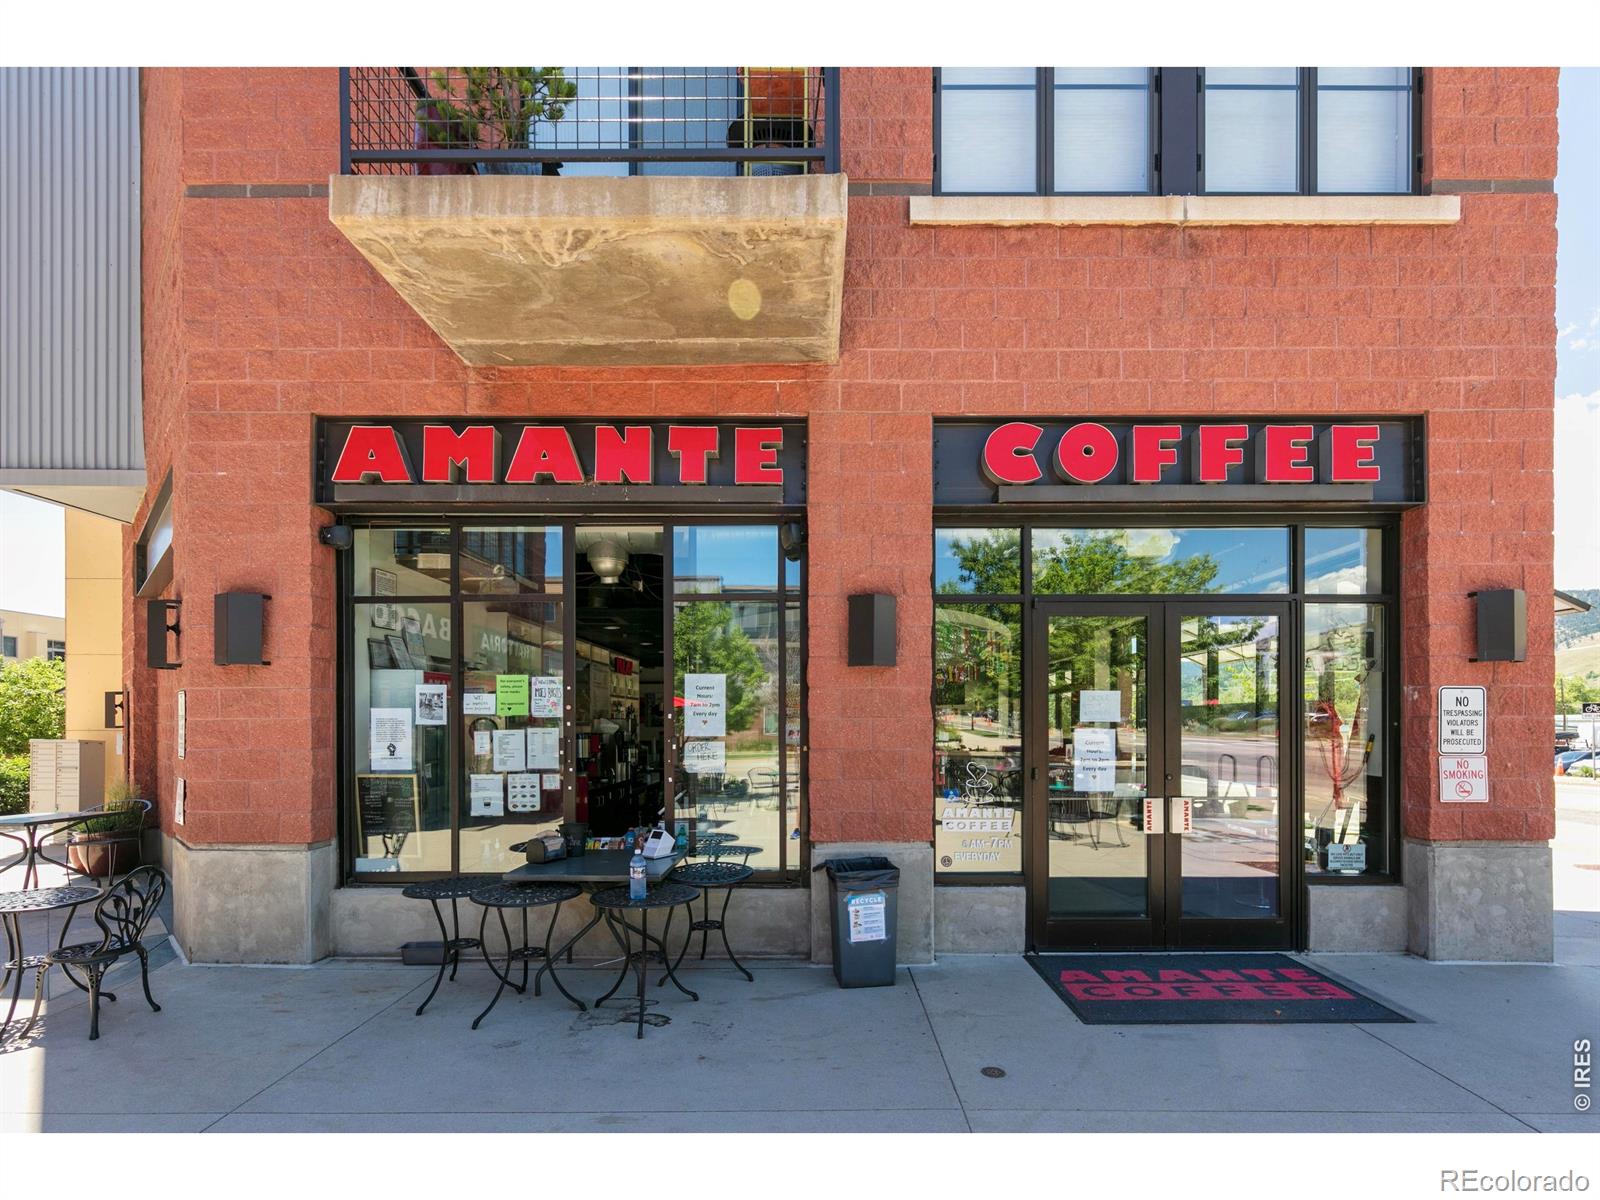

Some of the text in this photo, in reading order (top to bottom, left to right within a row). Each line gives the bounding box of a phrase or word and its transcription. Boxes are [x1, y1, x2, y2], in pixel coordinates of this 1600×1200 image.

[331, 425, 784, 484] AMANTE
[982, 422, 1381, 484] COFFEE
[1455, 696, 1469, 707] NO
[1443, 709, 1482, 717] TRESPASSING
[1456, 759, 1469, 769] NO
[1443, 770, 1484, 780] SMOKING
[942, 807, 1015, 818] AMANTE
[946, 821, 1010, 831] COFFEE
[953, 851, 1000, 862] EVERYDAY
[851, 896, 882, 905] RECYCLE
[1060, 968, 1322, 983] AMANTE
[1080, 985, 1337, 998] COFFEE
